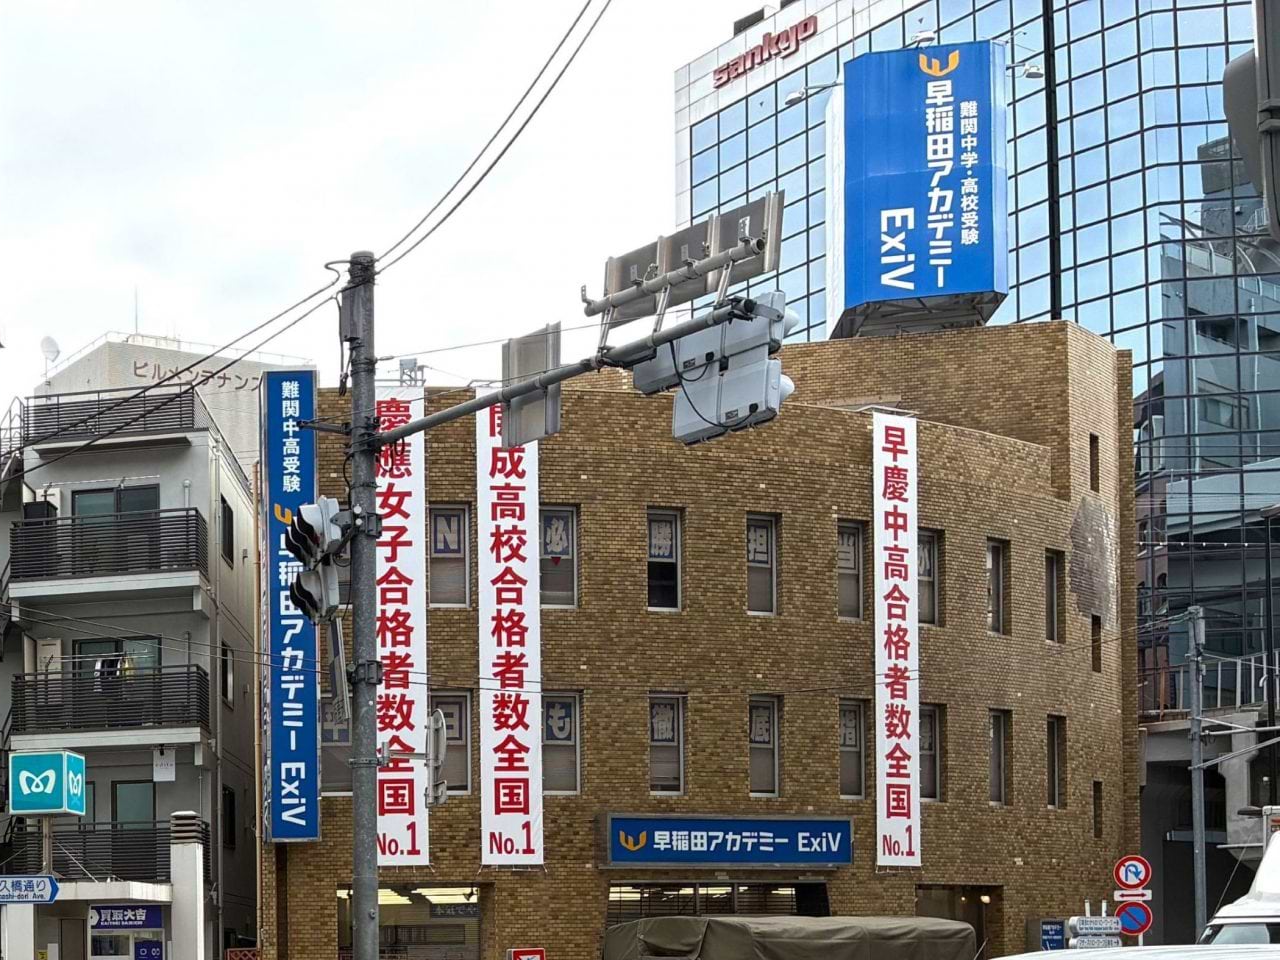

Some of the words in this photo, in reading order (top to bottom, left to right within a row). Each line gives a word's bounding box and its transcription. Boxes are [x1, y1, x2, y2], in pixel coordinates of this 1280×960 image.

[713, 15, 817, 88] sankyo
[926, 80, 954, 288] 早稲田アカデミー
[960, 101, 979, 244] 難関中学・高校受験
[880, 208, 915, 290] ExiV
[282, 381, 300, 492] 難関中高受験
[279, 762, 306, 826] ExiV
[653, 830, 789, 852] 早稲田アカデミー
[797, 831, 842, 852] ExiV
[100, 908, 147, 921] 買取大吉
